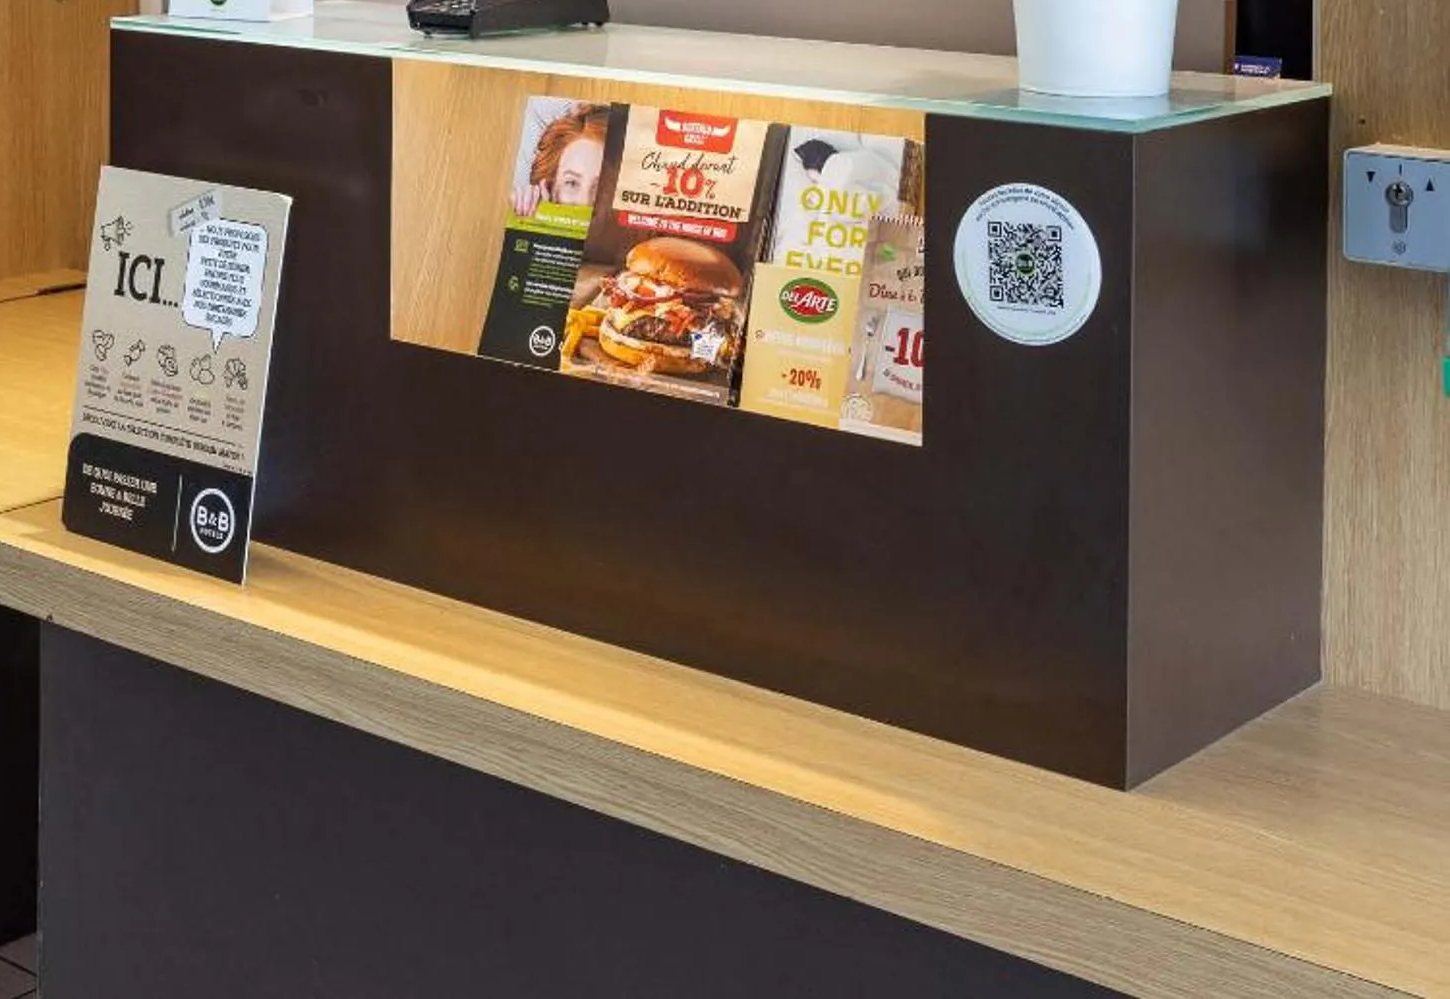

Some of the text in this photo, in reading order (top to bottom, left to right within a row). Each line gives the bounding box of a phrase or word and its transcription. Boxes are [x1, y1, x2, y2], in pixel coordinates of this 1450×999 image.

[621, 190, 742, 220] SUR L'ADDITION
[801, 185, 883, 219] ONLY
[807, 220, 868, 248] FOR
[196, 505, 230, 532] B&B
